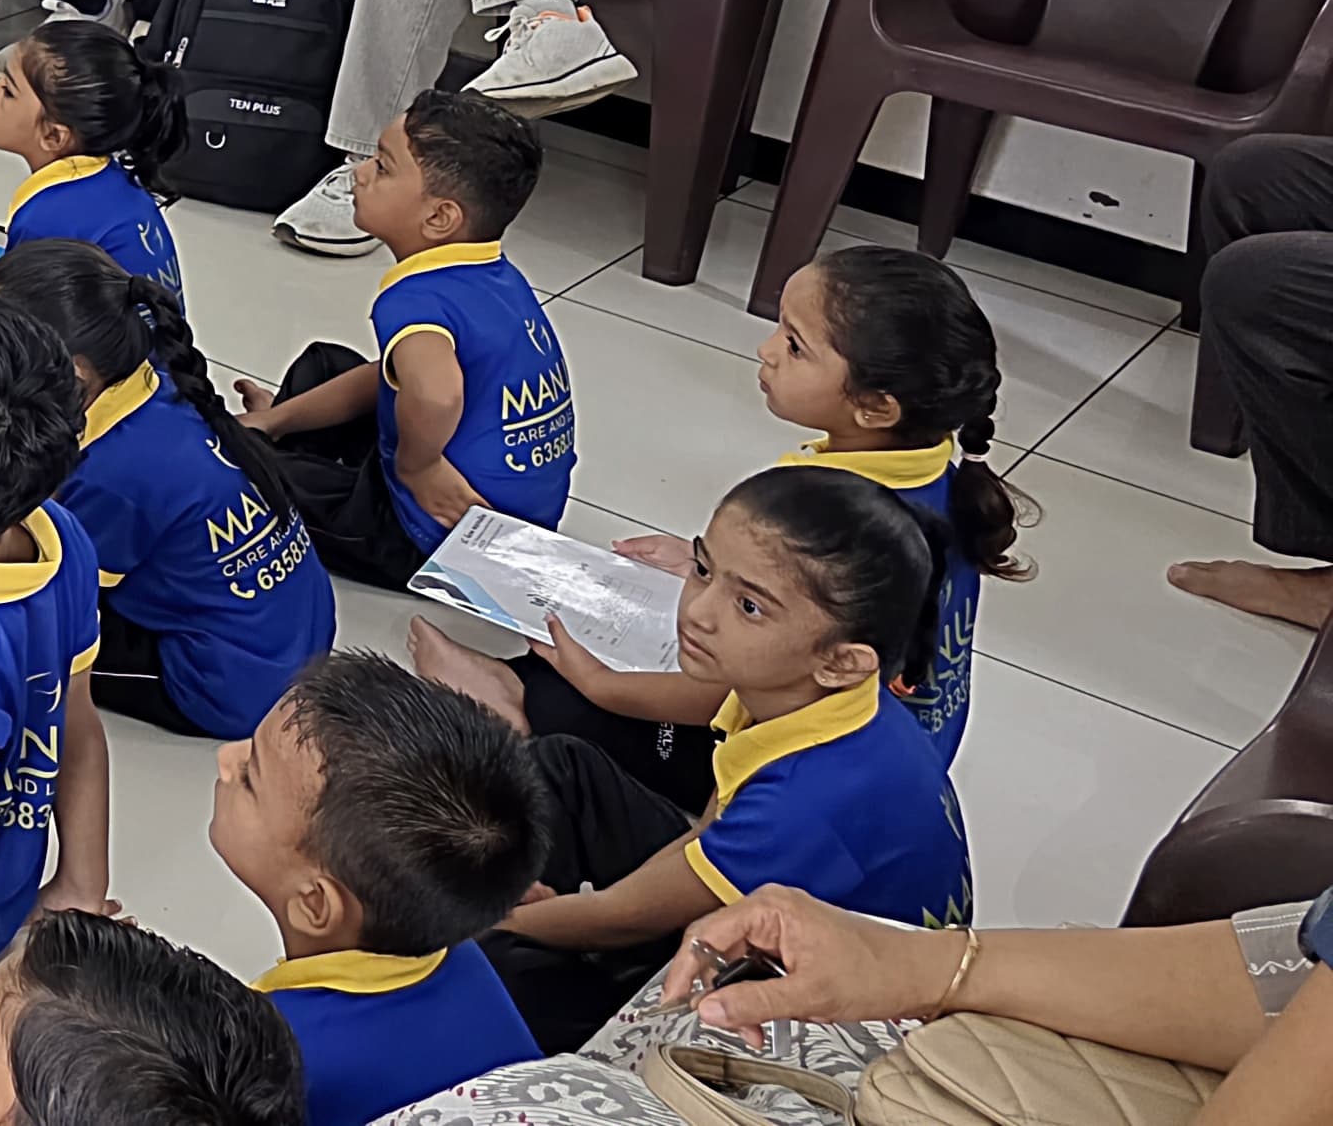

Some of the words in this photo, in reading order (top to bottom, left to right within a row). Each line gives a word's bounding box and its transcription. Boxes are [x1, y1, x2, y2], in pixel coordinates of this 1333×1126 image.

[229, 98, 251, 111] TEN
[253, 102, 282, 116] PLUS
[504, 426, 547, 447] CARE
[222, 544, 269, 578] CARE
